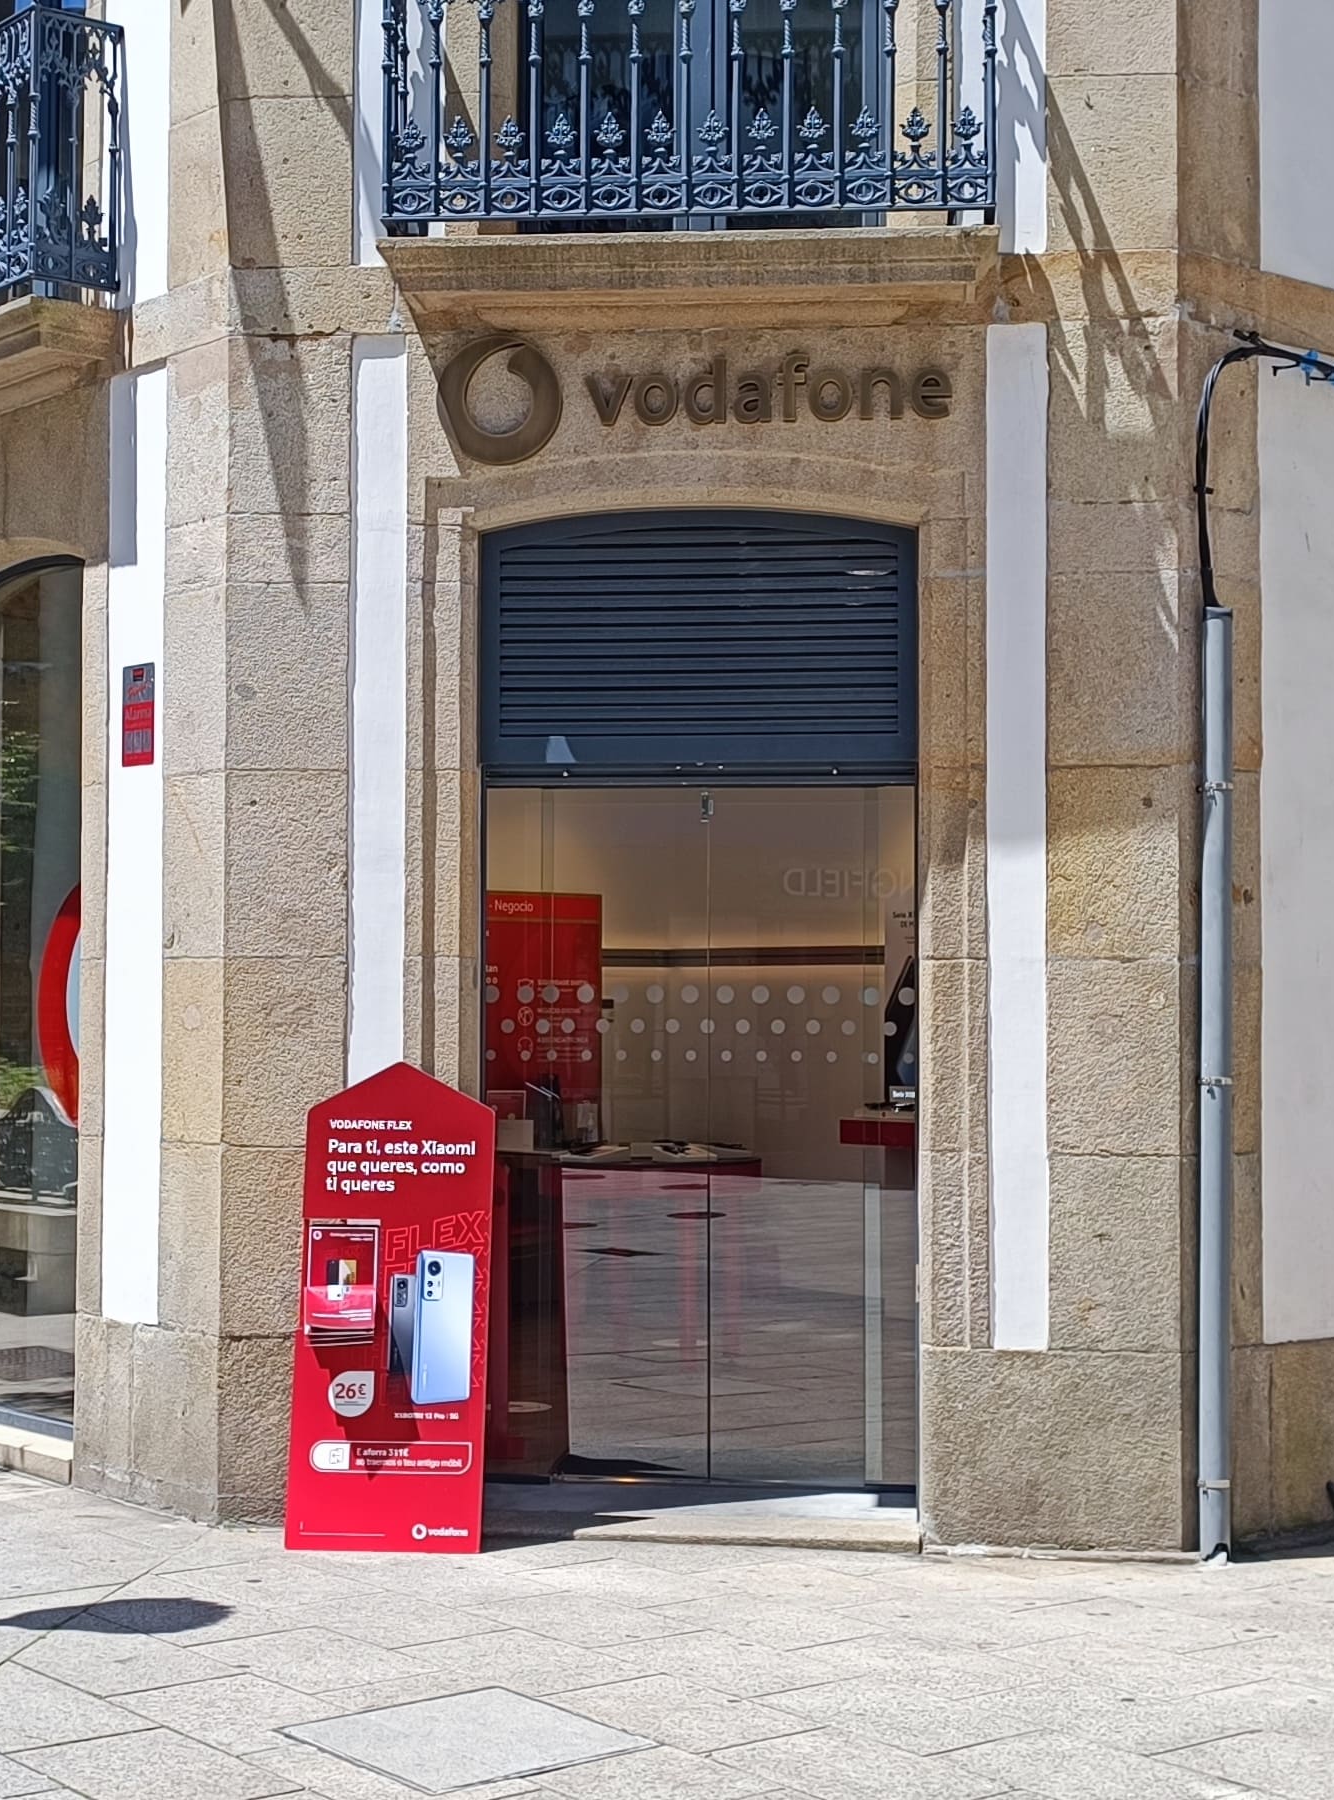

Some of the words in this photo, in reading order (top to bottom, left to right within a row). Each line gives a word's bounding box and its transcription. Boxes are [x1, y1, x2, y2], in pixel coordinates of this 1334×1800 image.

[583, 350, 954, 427] vodafone
[494, 899, 534, 914] Negocio
[329, 1119, 385, 1130] VODAFONE
[387, 1120, 413, 1131] FLEX
[327, 1138, 363, 1154] Para
[384, 1141, 419, 1155] este
[420, 1139, 476, 1156] Xiaomi
[326, 1160, 357, 1175] que
[360, 1161, 418, 1176] queres,
[420, 1161, 466, 1174] como
[325, 1176, 338, 1192] ti
[340, 1178, 396, 1195] queres
[384, 1210, 485, 1262] FLEX
[334, 1383, 367, 1400] 26€
[427, 1527, 469, 1537] vodafone
